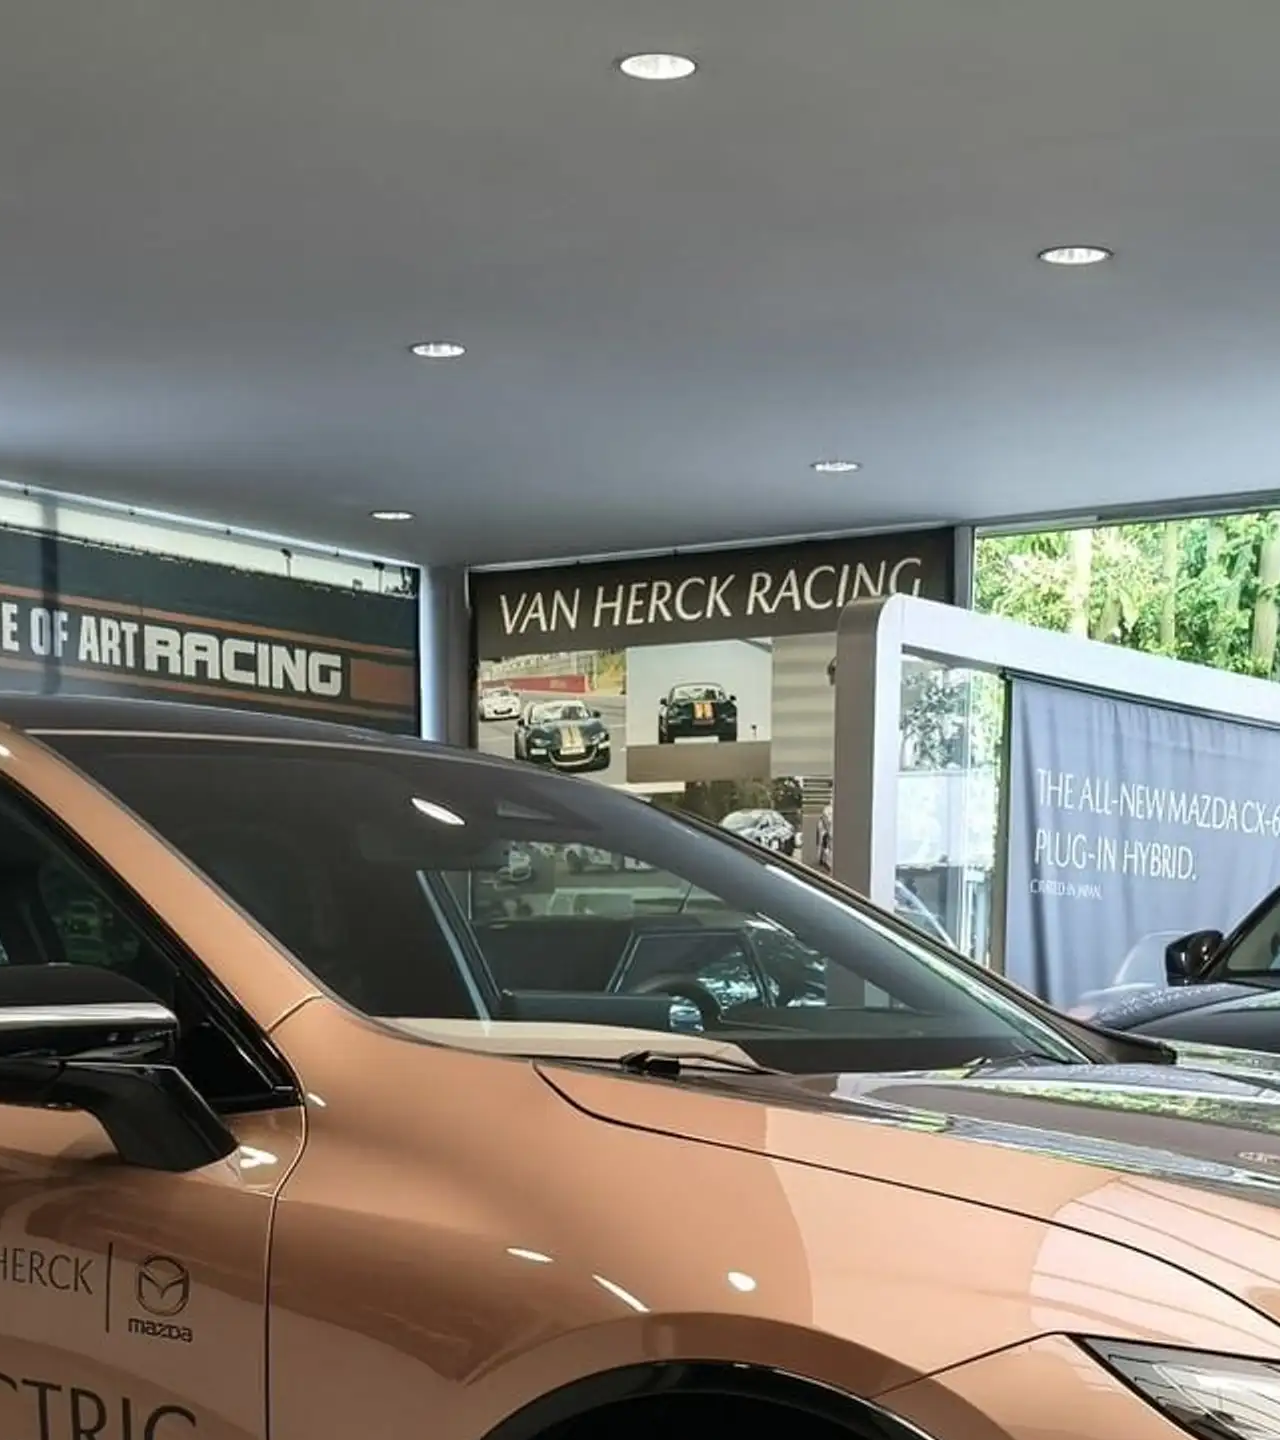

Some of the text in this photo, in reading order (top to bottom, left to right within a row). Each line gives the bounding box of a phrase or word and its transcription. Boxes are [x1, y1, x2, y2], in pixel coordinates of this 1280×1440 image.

[500, 557, 922, 635] VAN HERCK RACING
[29, 606, 69, 658] OF
[78, 615, 139, 668] ART
[143, 624, 342, 697] RACING
[1036, 768, 1074, 810] THE
[1077, 777, 1166, 825] ALL-NEW
[1168, 790, 1239, 831] MAZDA
[1034, 828, 1197, 881] PLUG-IN HYBRID.
